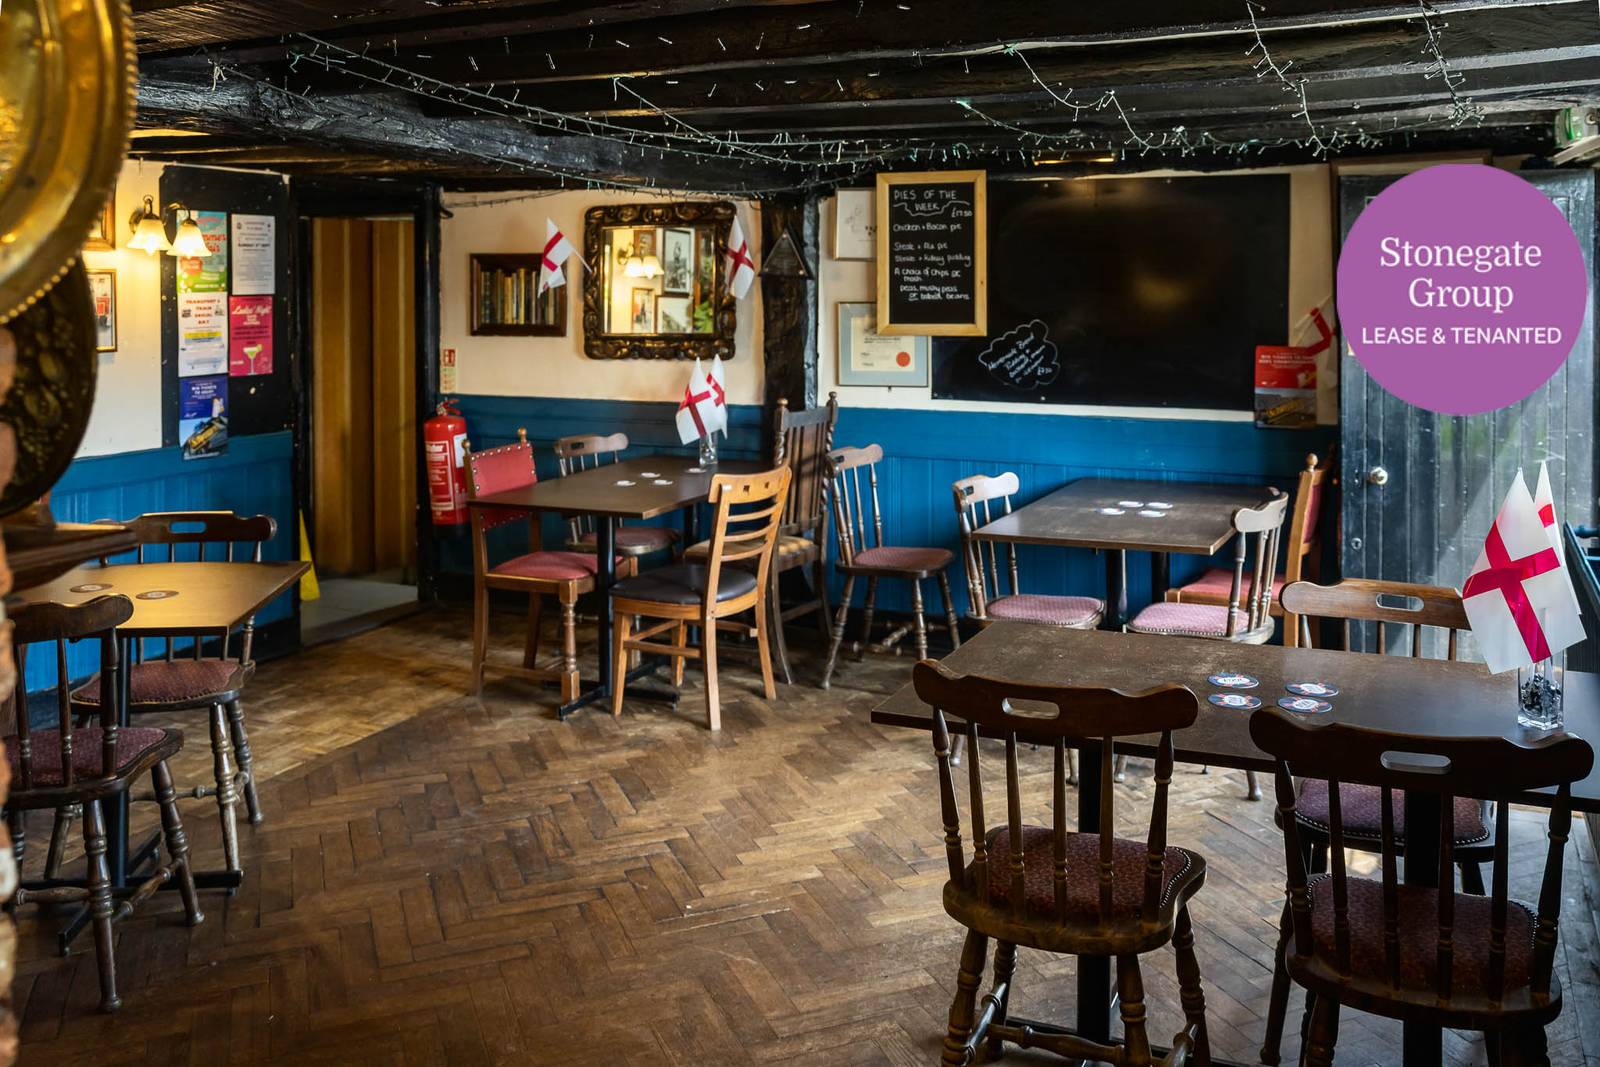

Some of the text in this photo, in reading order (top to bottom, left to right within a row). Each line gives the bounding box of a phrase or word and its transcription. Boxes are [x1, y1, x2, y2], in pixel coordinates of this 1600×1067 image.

[893, 189, 957, 200] PIES OF THE
[914, 202, 940, 212] WEEK
[892, 223, 921, 232] Chicken
[926, 222, 948, 231] Bacon
[950, 223, 962, 232] pie
[893, 241, 915, 251] Steak
[937, 242, 948, 251] pie
[894, 267, 900, 275] A
[908, 292, 919, 300] or
